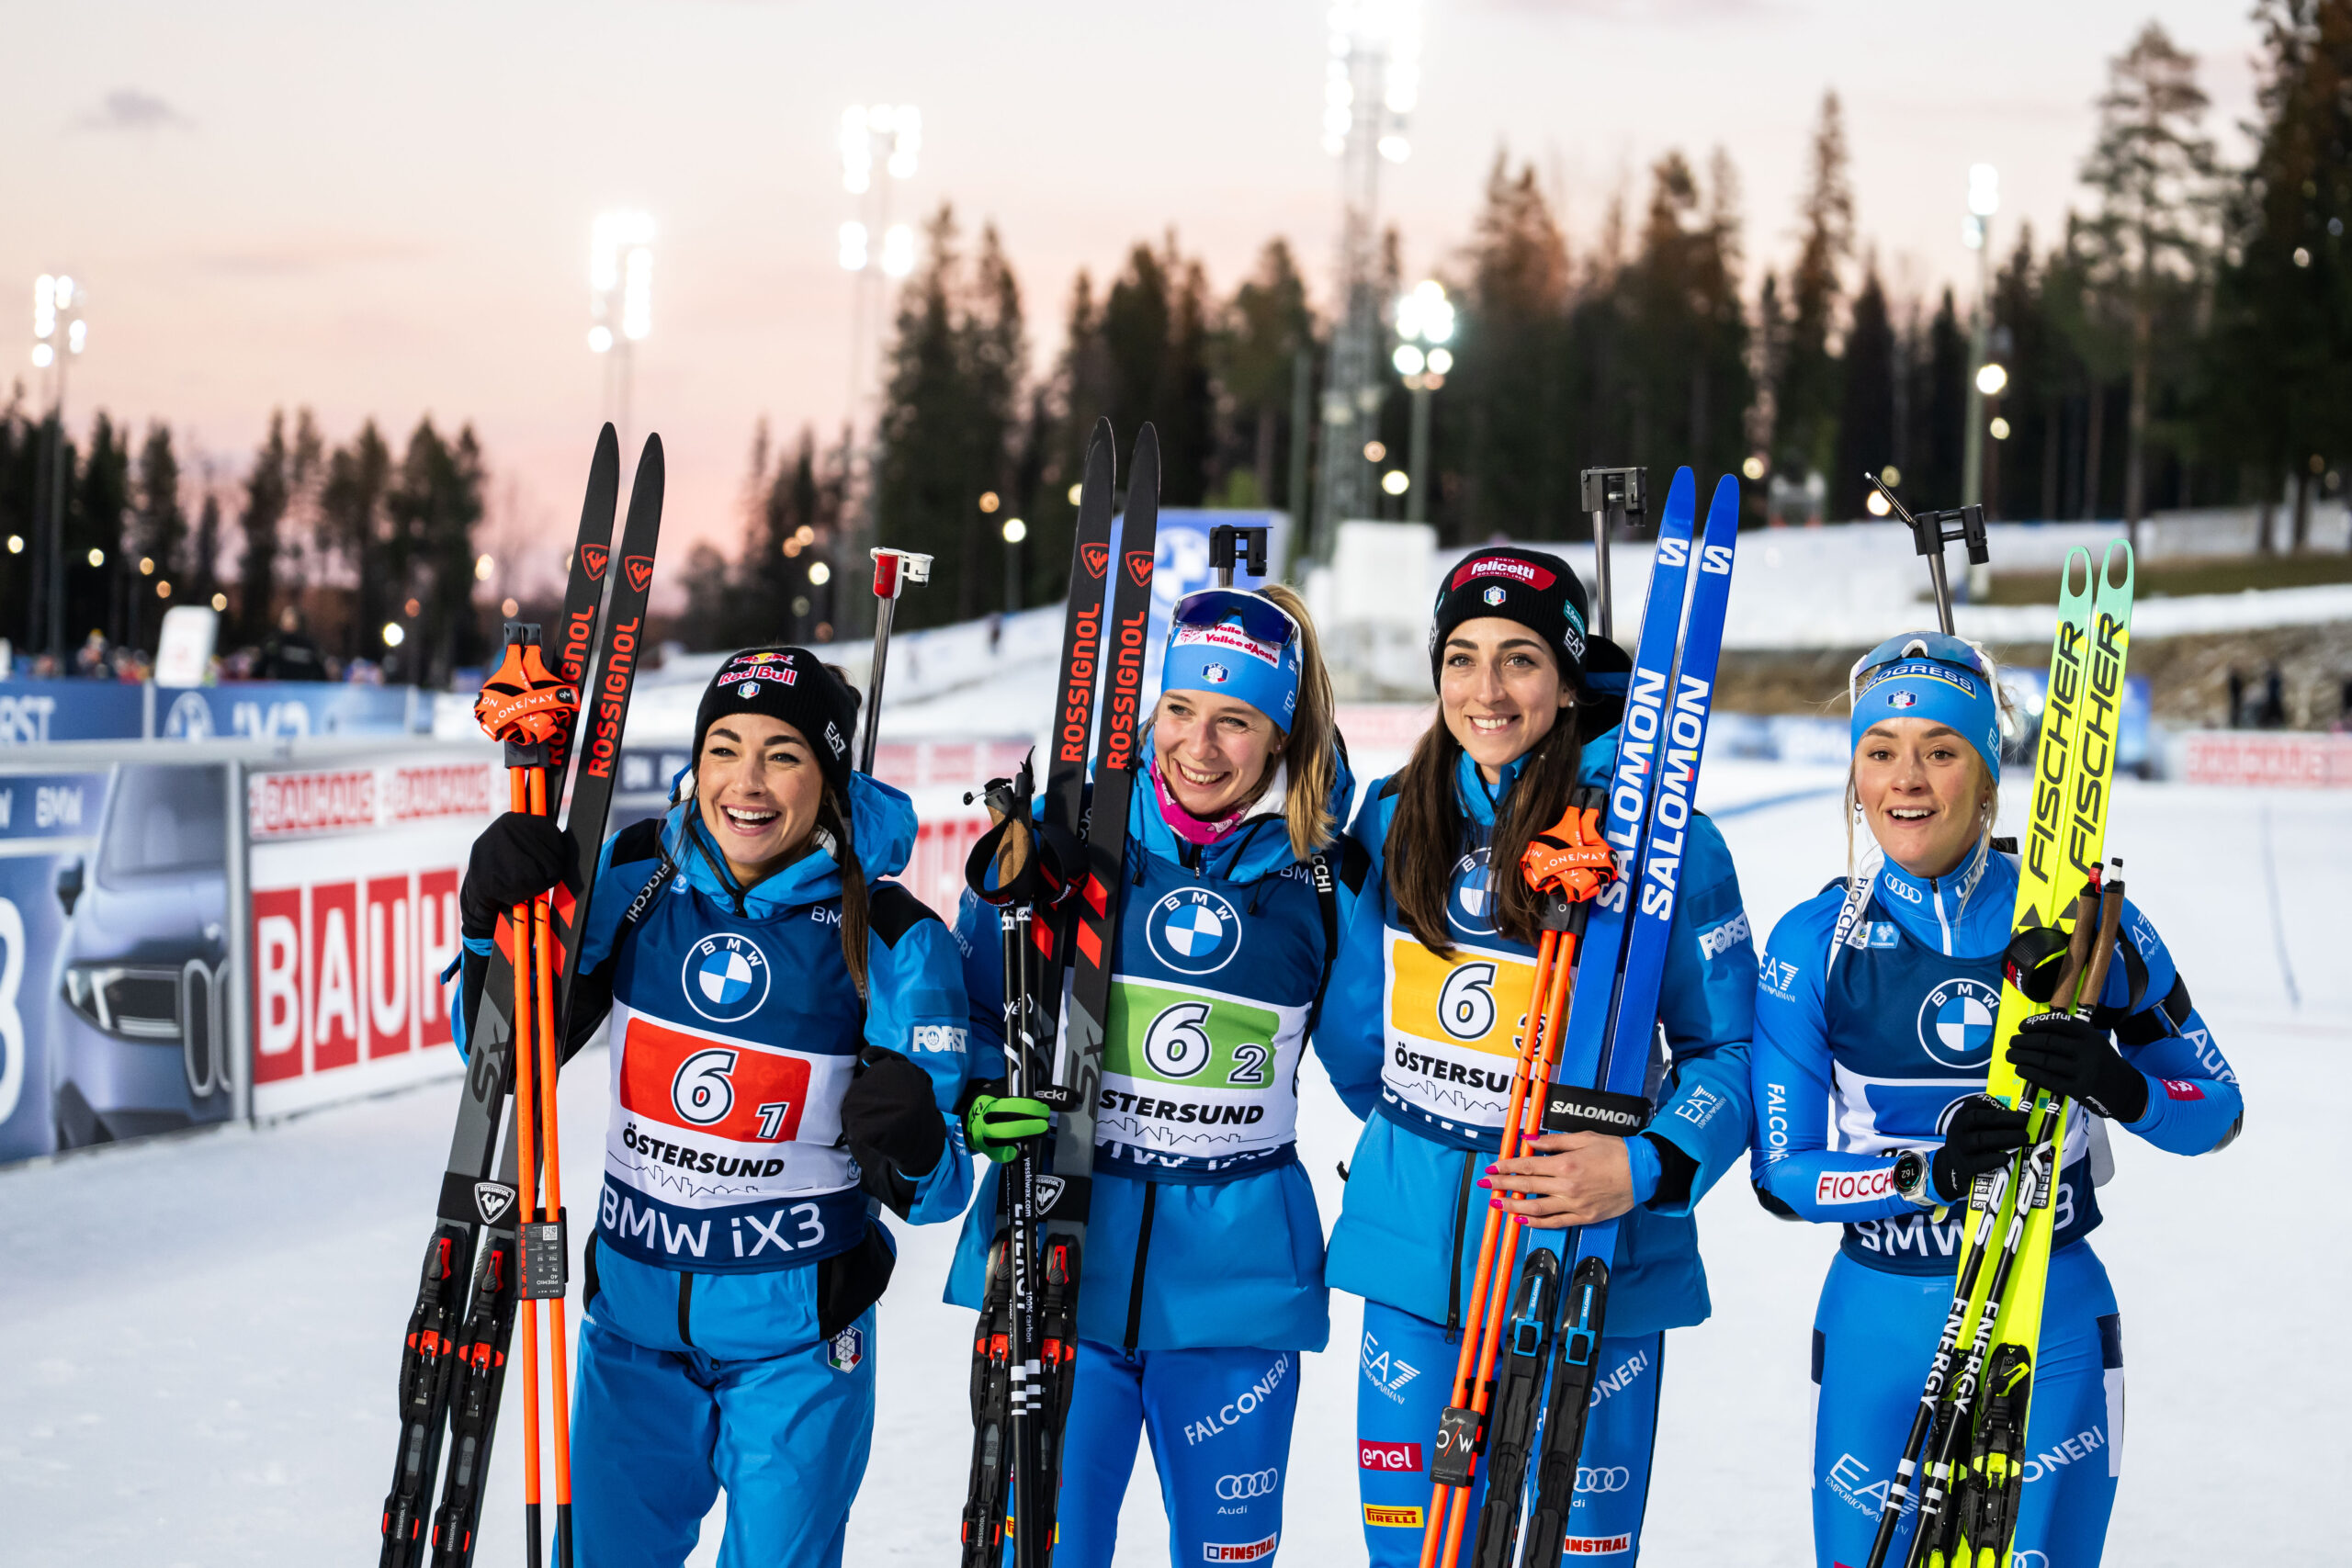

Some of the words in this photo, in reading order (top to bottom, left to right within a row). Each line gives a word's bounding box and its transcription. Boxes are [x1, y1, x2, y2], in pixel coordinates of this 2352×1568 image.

[1470, 560, 1534, 580] felicetti
[1205, 634, 1243, 648] Vallée
[1214, 625, 1241, 635] Valle
[1565, 627, 1586, 658] EA7
[718, 665, 757, 687] Red
[756, 665, 797, 686] Bull
[1060, 604, 1100, 761] ROSSIGNOL
[1107, 612, 1145, 769] ROSSIGNOL
[1866, 665, 1973, 691] ROGRESS
[588, 617, 639, 778] ROSSIGNOL
[2029, 620, 2084, 884] FISCHER
[2069, 612, 2124, 876] FISCHER
[1596, 667, 1666, 913] SALOMON
[1642, 674, 1709, 920] SALOMON
[1280, 865, 1315, 886] BM
[626, 863, 671, 923] FIOCCHI
[1164, 891, 1233, 921] BMW
[810, 906, 842, 929] BM
[1835, 877, 1869, 944] FIOCCHI
[701, 938, 763, 967] BMW
[1436, 961, 1499, 1042] 6
[1931, 983, 2000, 1009] BMW
[2026, 1012, 2071, 1024] sportful
[912, 1025, 967, 1054] FORST
[1142, 1000, 1213, 1080] 6
[1227, 1043, 1268, 1084] 2
[1395, 1042, 1514, 1095] ÖSTERSU
[672, 1048, 739, 1126] 6
[755, 1102, 789, 1139] 1
[1099, 1089, 1264, 1125] STERSUND
[1674, 1085, 1717, 1124] EA7
[1550, 1100, 1642, 1128] SALOMON
[623, 1122, 785, 1178] ÖSTERSUND
[1818, 1169, 1895, 1201] FIOCCH
[1901, 1168, 1915, 1179] 162
[480, 1186, 509, 1197] ROSSIGNOL
[602, 1181, 711, 1258] BMW
[731, 1202, 825, 1258] iX3
[1362, 1331, 1421, 1391] EA7
[1920, 1297, 1968, 1414] ENERGY
[1953, 1300, 2000, 1415] ENERGY
[1184, 1353, 1290, 1446] FALCONERI
[1362, 1446, 1412, 1469] enel
[2022, 1425, 2106, 1483] ONERI
[1825, 1475, 1863, 1511] EMPORIO
[1216, 1505, 1248, 1515] Audi
[1366, 1507, 1417, 1524] PIRELLI
[447, 1520, 457, 1551] ROSSIGNOL
[978, 1516, 986, 1547] ROSSIGNOL
[1565, 1538, 1628, 1553] INSTRAL
[1220, 1535, 1275, 1561] FINSTRAL
